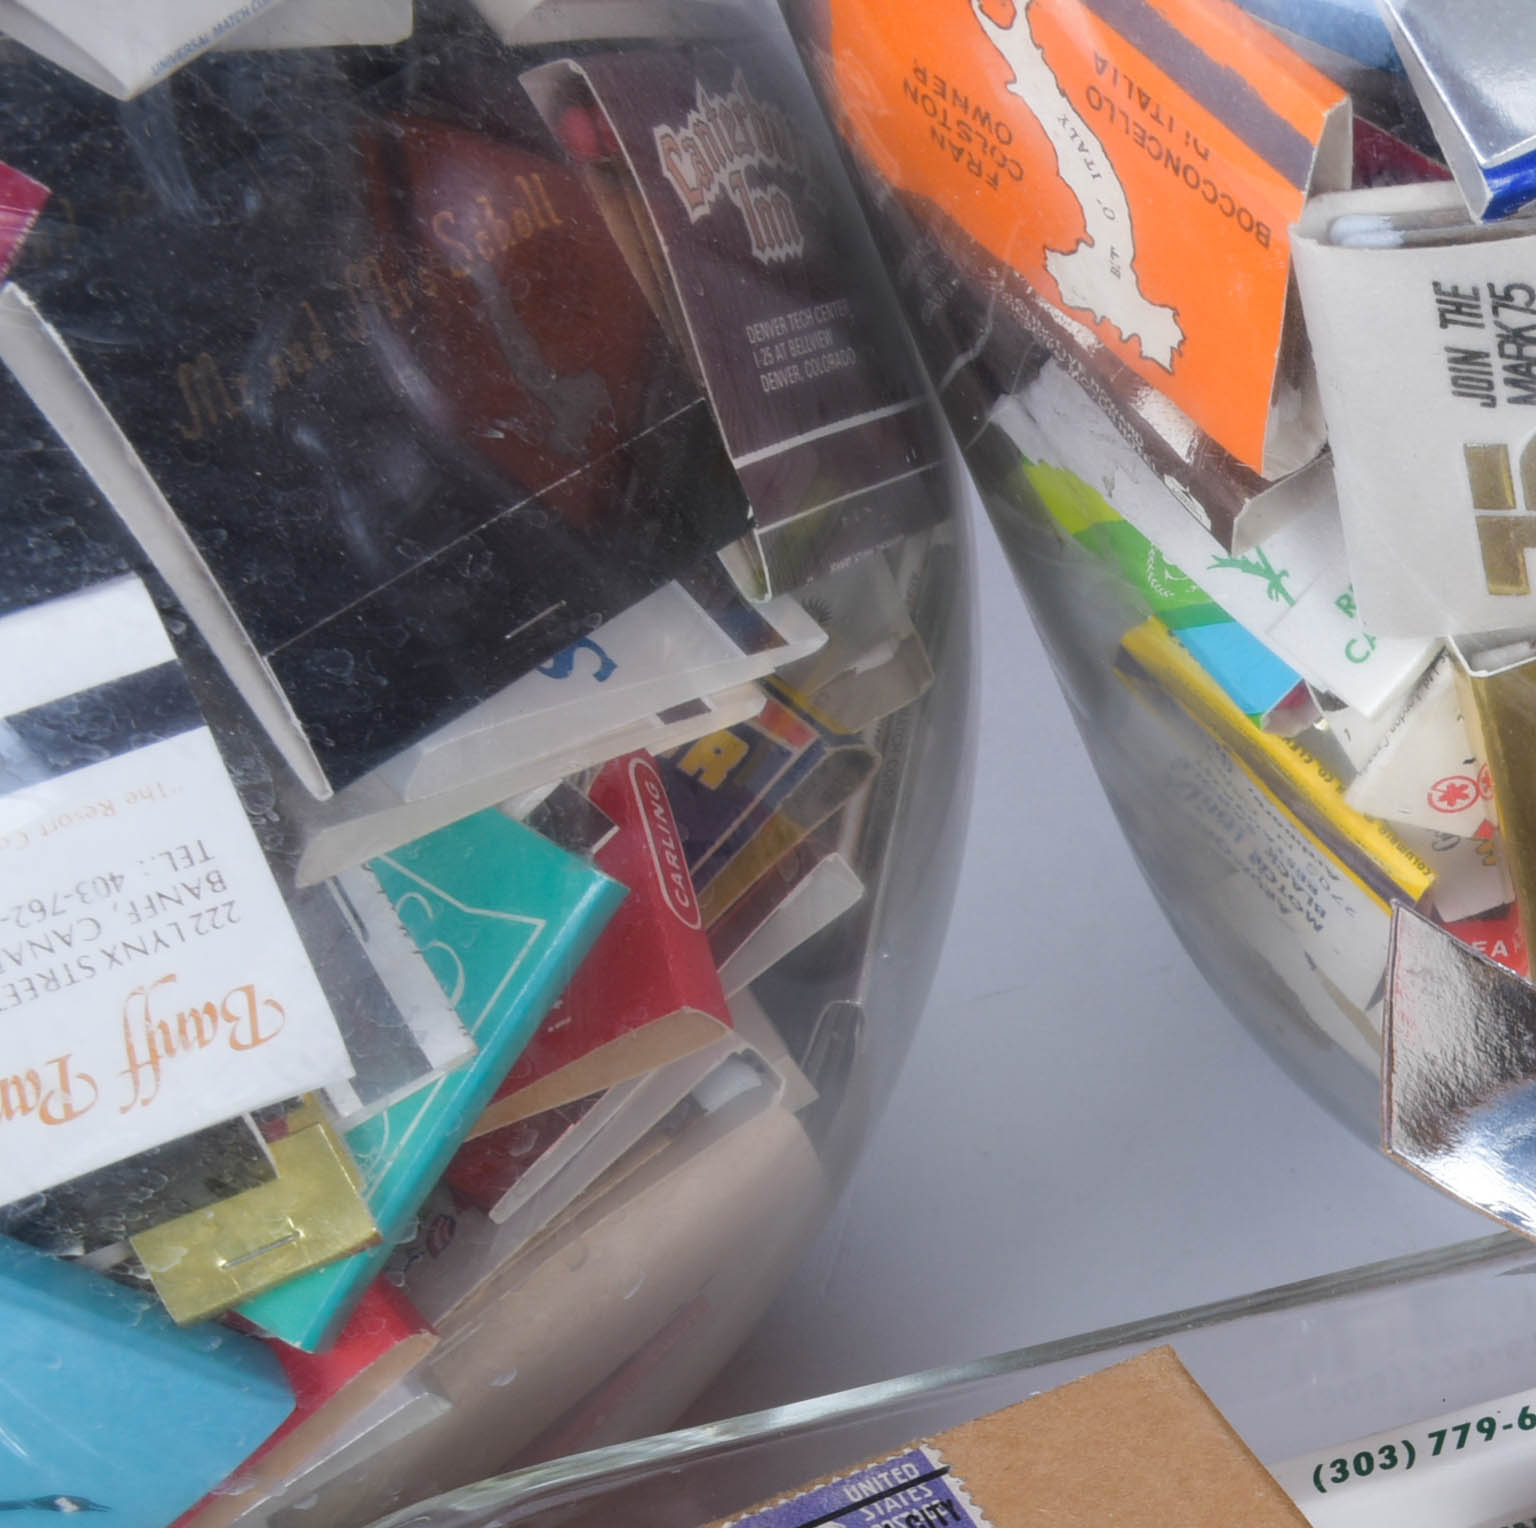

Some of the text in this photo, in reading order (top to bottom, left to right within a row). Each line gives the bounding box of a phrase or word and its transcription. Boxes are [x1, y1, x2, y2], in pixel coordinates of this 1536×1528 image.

[913, 59, 1014, 147] OWNER
[1093, 51, 1175, 132] ITALIA
[903, 77, 1024, 182] COLSTON
[931, 128, 1000, 191] FRAN
[1057, 113, 1103, 181] ITALY
[1085, 84, 1273, 250] BOCCONCELLO
[433, 172, 564, 264] Scholl
[746, 307, 814, 343] DENVER TECH
[1432, 281, 1497, 408] JOIN THE
[805, 348, 857, 380] COLORADO
[645, 781, 692, 908] CARLING
[113, 870, 228, 926] BANFF,
[191, 900, 241, 936] 222
[102, 920, 187, 971] LYNX
[118, 972, 286, 1114] Banff
[843, 1462, 921, 1502] UNITED
[1311, 1439, 1418, 1494] (303)
[857, 1483, 935, 1521] STATES
